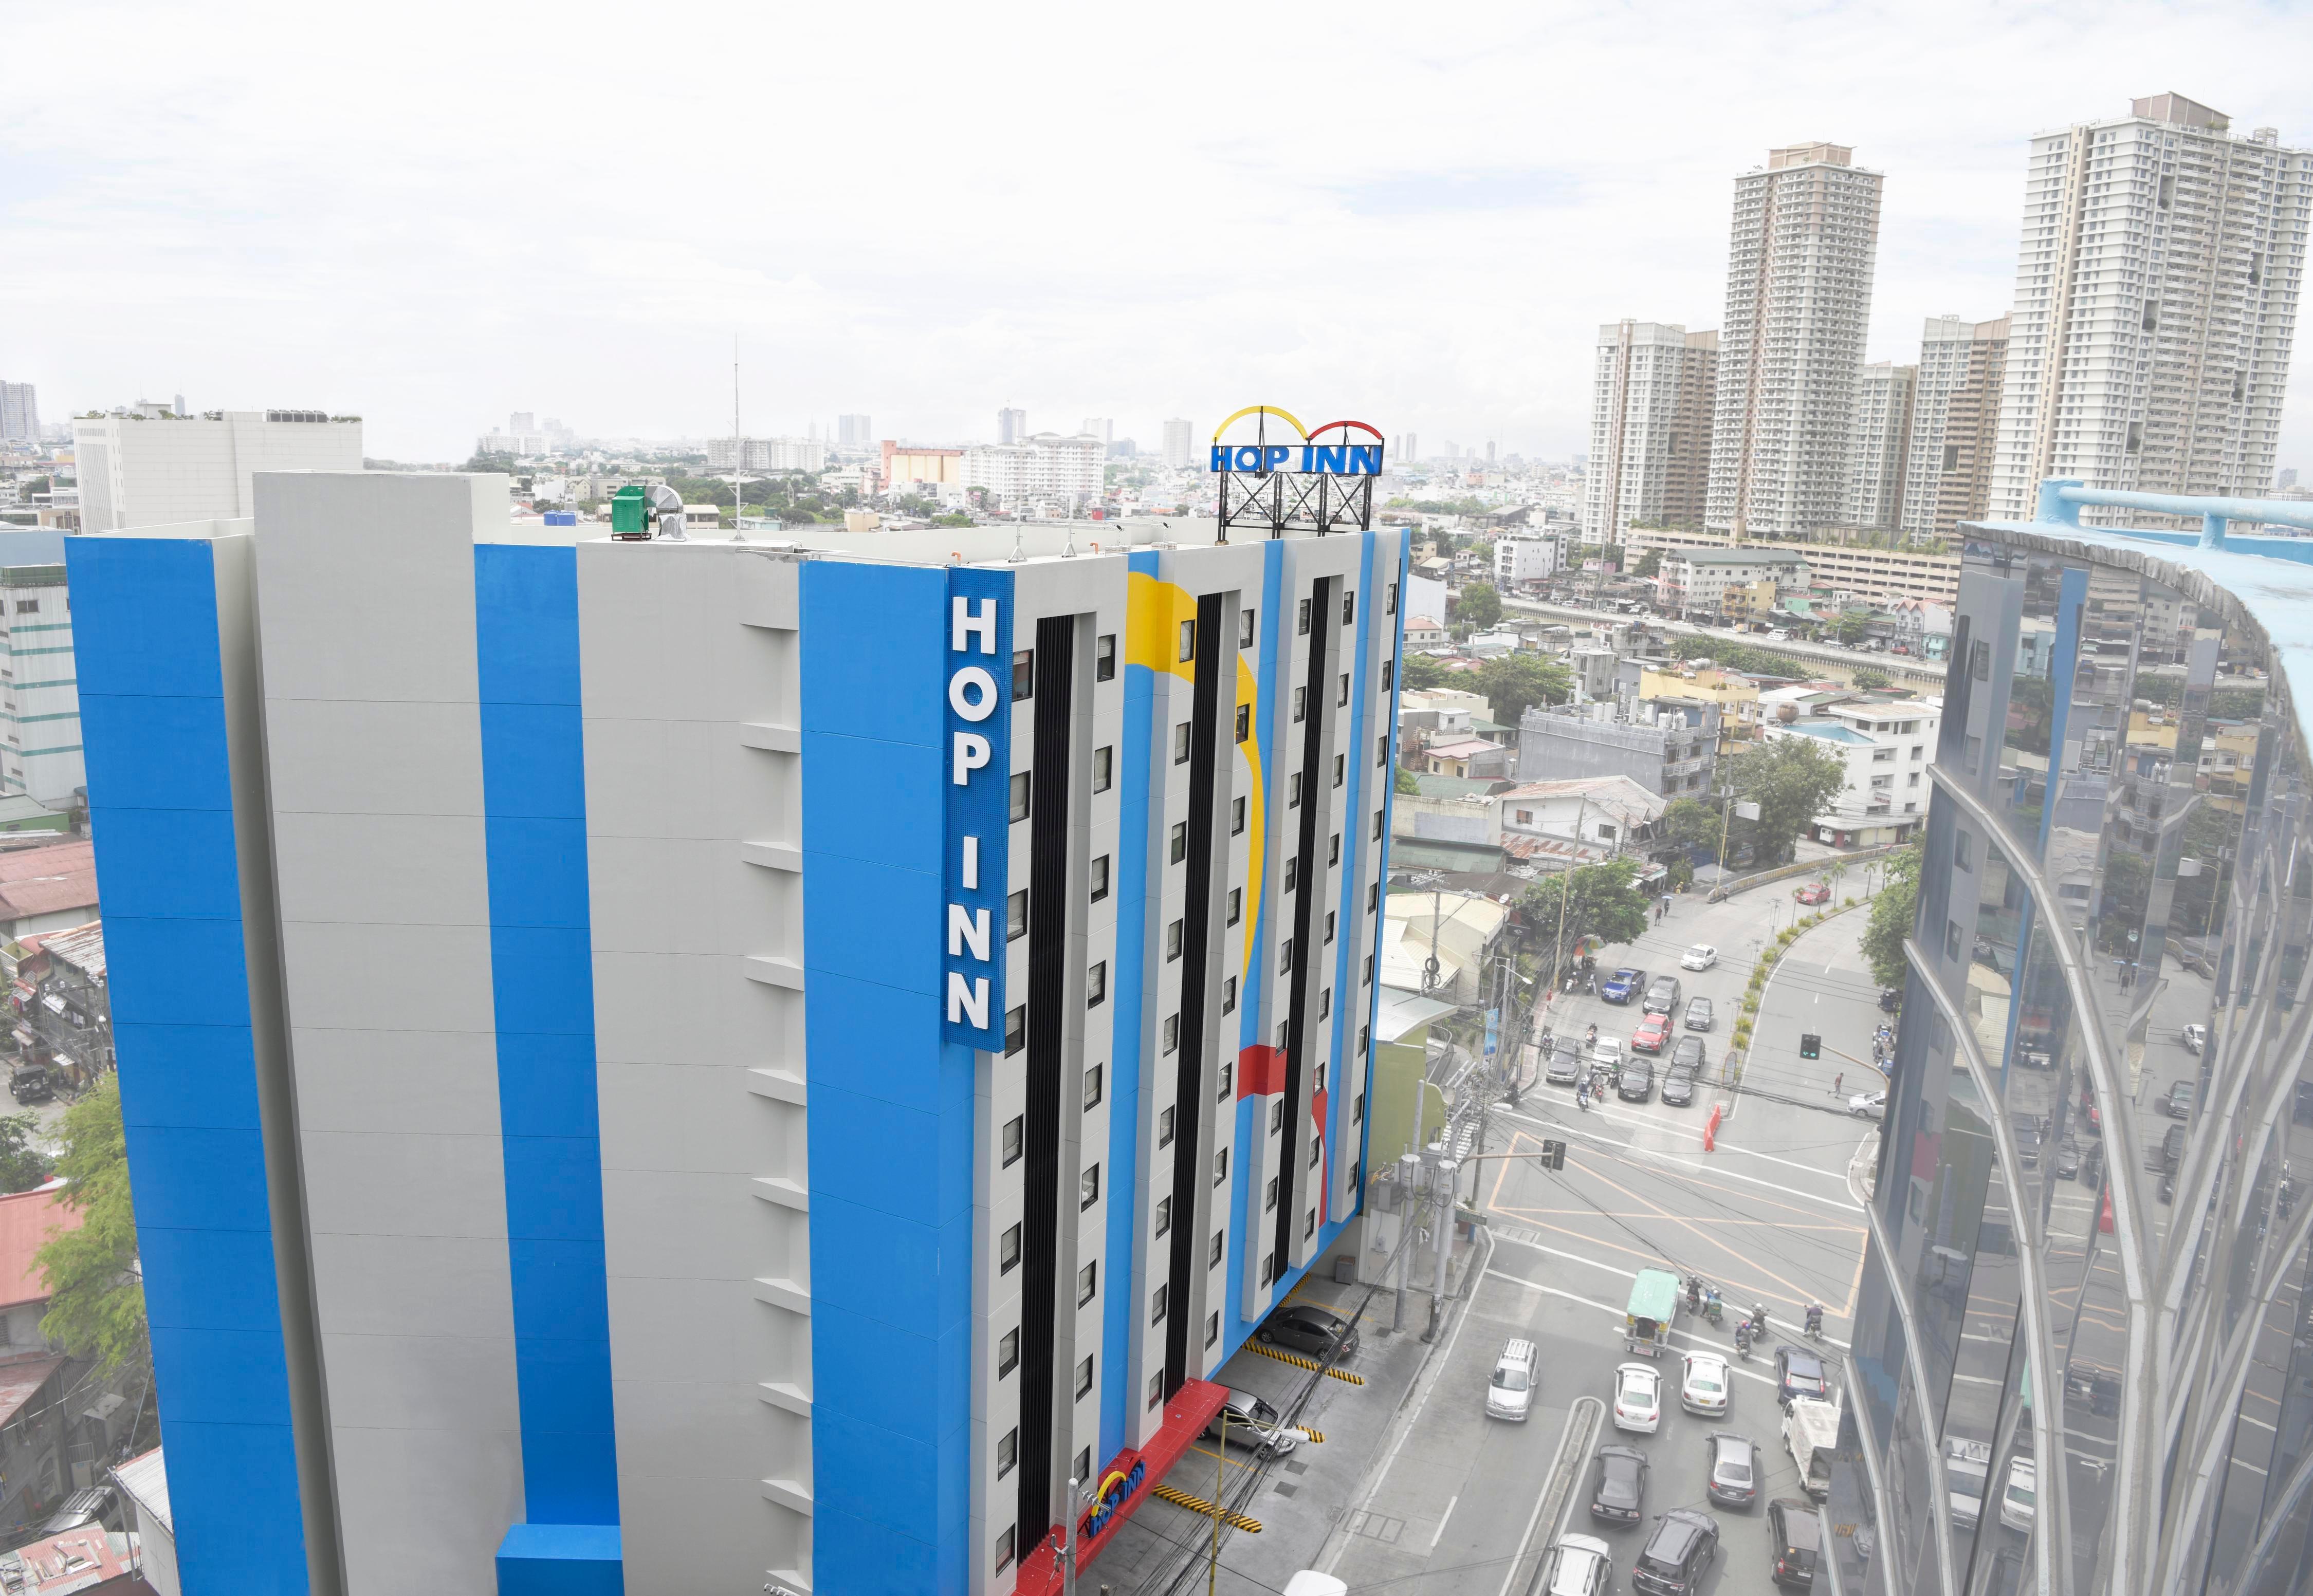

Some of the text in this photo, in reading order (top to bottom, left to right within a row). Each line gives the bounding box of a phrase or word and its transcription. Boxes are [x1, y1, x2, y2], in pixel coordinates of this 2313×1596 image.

[1210, 446, 1382, 475] HOP INN
[948, 596, 997, 1030] HOP INN
[1090, 1461, 1146, 1537] HOP INN
